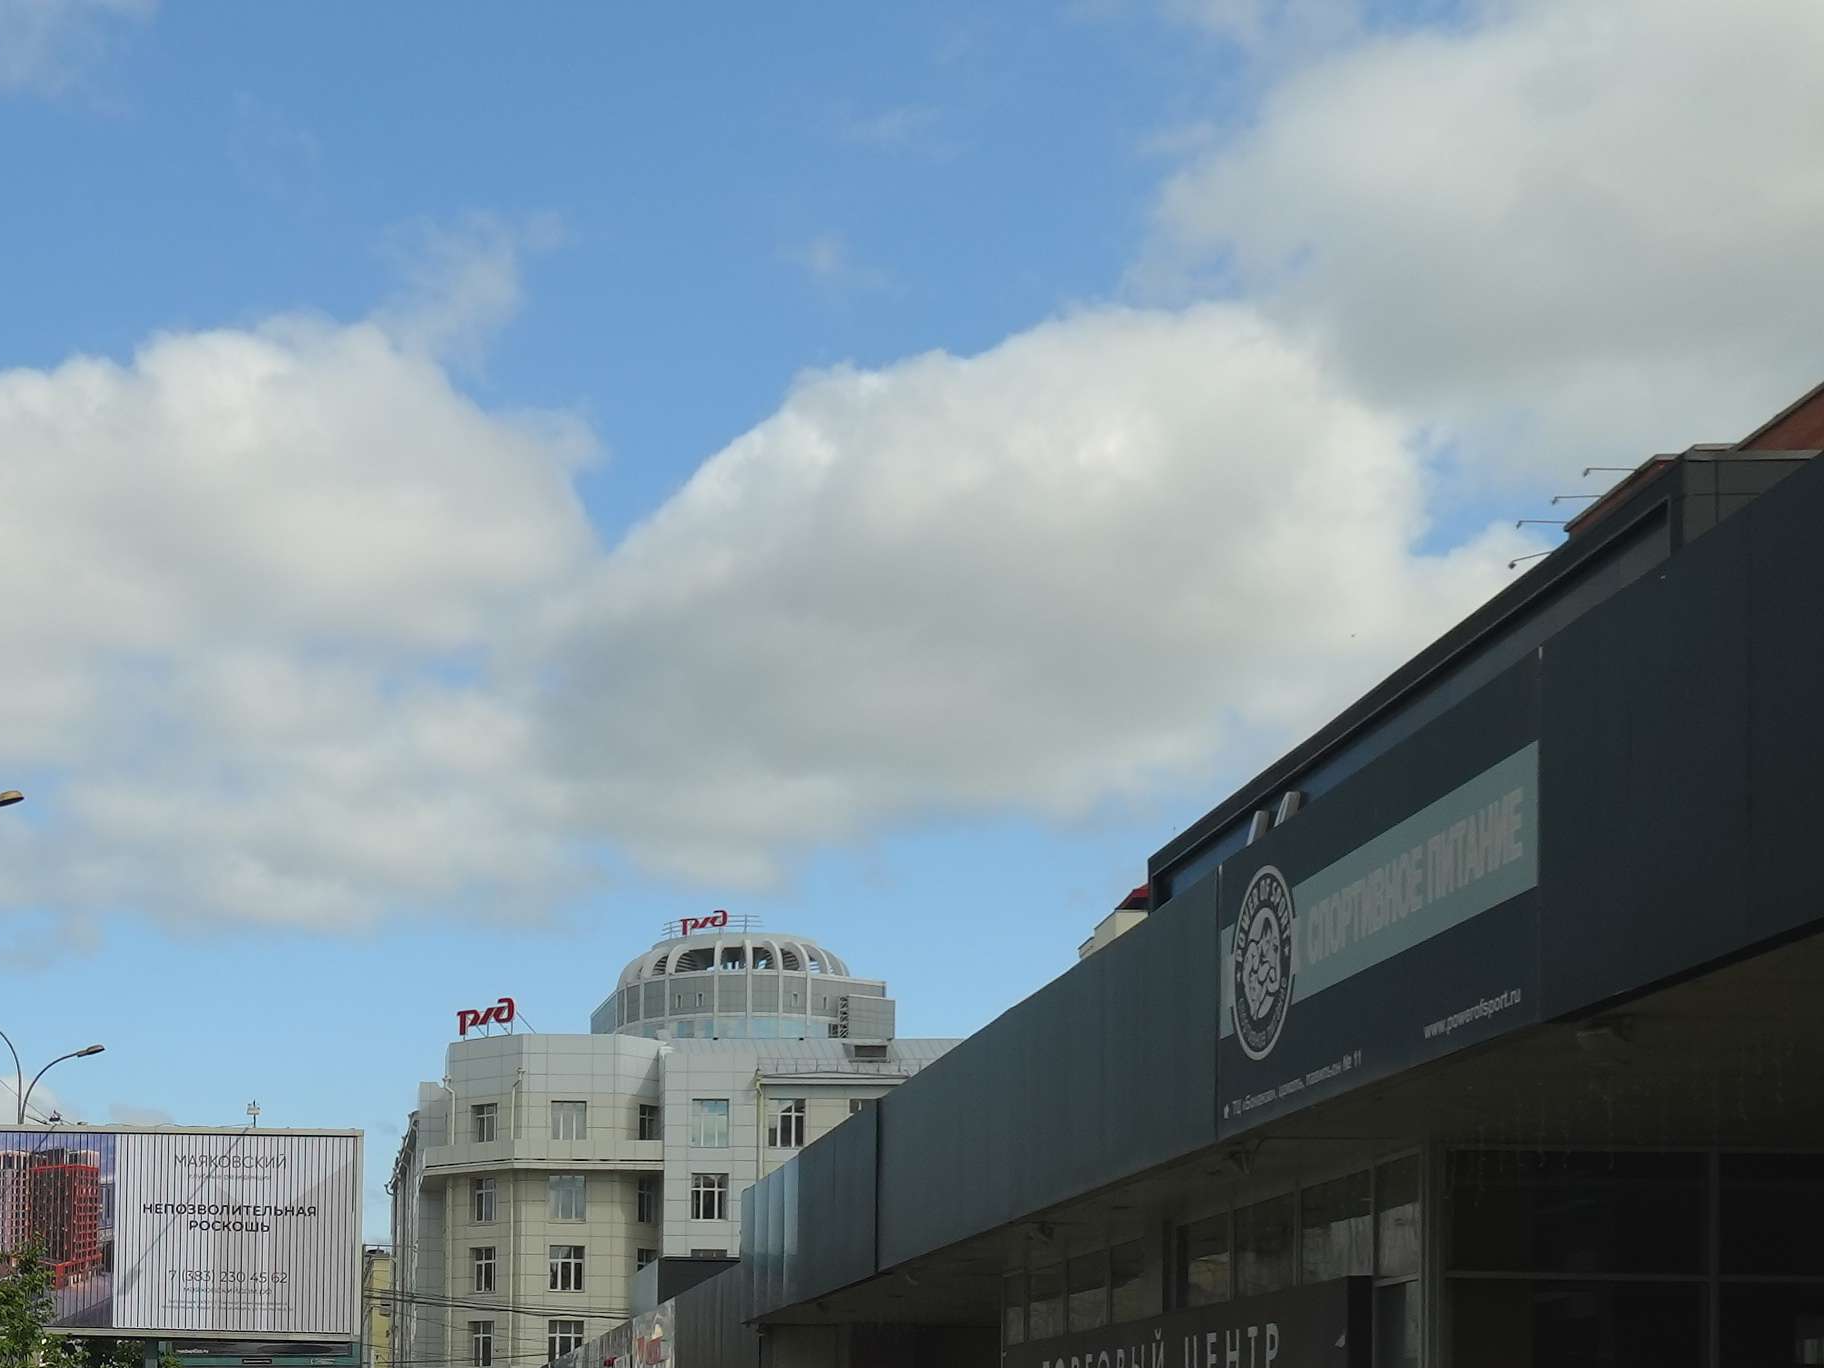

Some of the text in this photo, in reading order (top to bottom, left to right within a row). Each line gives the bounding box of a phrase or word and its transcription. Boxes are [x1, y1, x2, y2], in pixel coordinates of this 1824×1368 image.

[1308, 788, 1523, 964] СПОРТИВНОЕ ПИТАНИЕ
[1236, 887, 1259, 963] POWER
[1271, 882, 1291, 940] SPORT
[1423, 988, 1521, 1040] www.powerofsport.ru
[175, 1154, 287, 1169] МАЯКОВСКИЙ
[142, 1202, 317, 1217] НЕПОЗВОЛИТЕЛЬНАЯ
[189, 1220, 270, 1233] РОСКОШЬ
[220, 1271, 246, 1283] 230
[250, 1272, 267, 1283] 45
